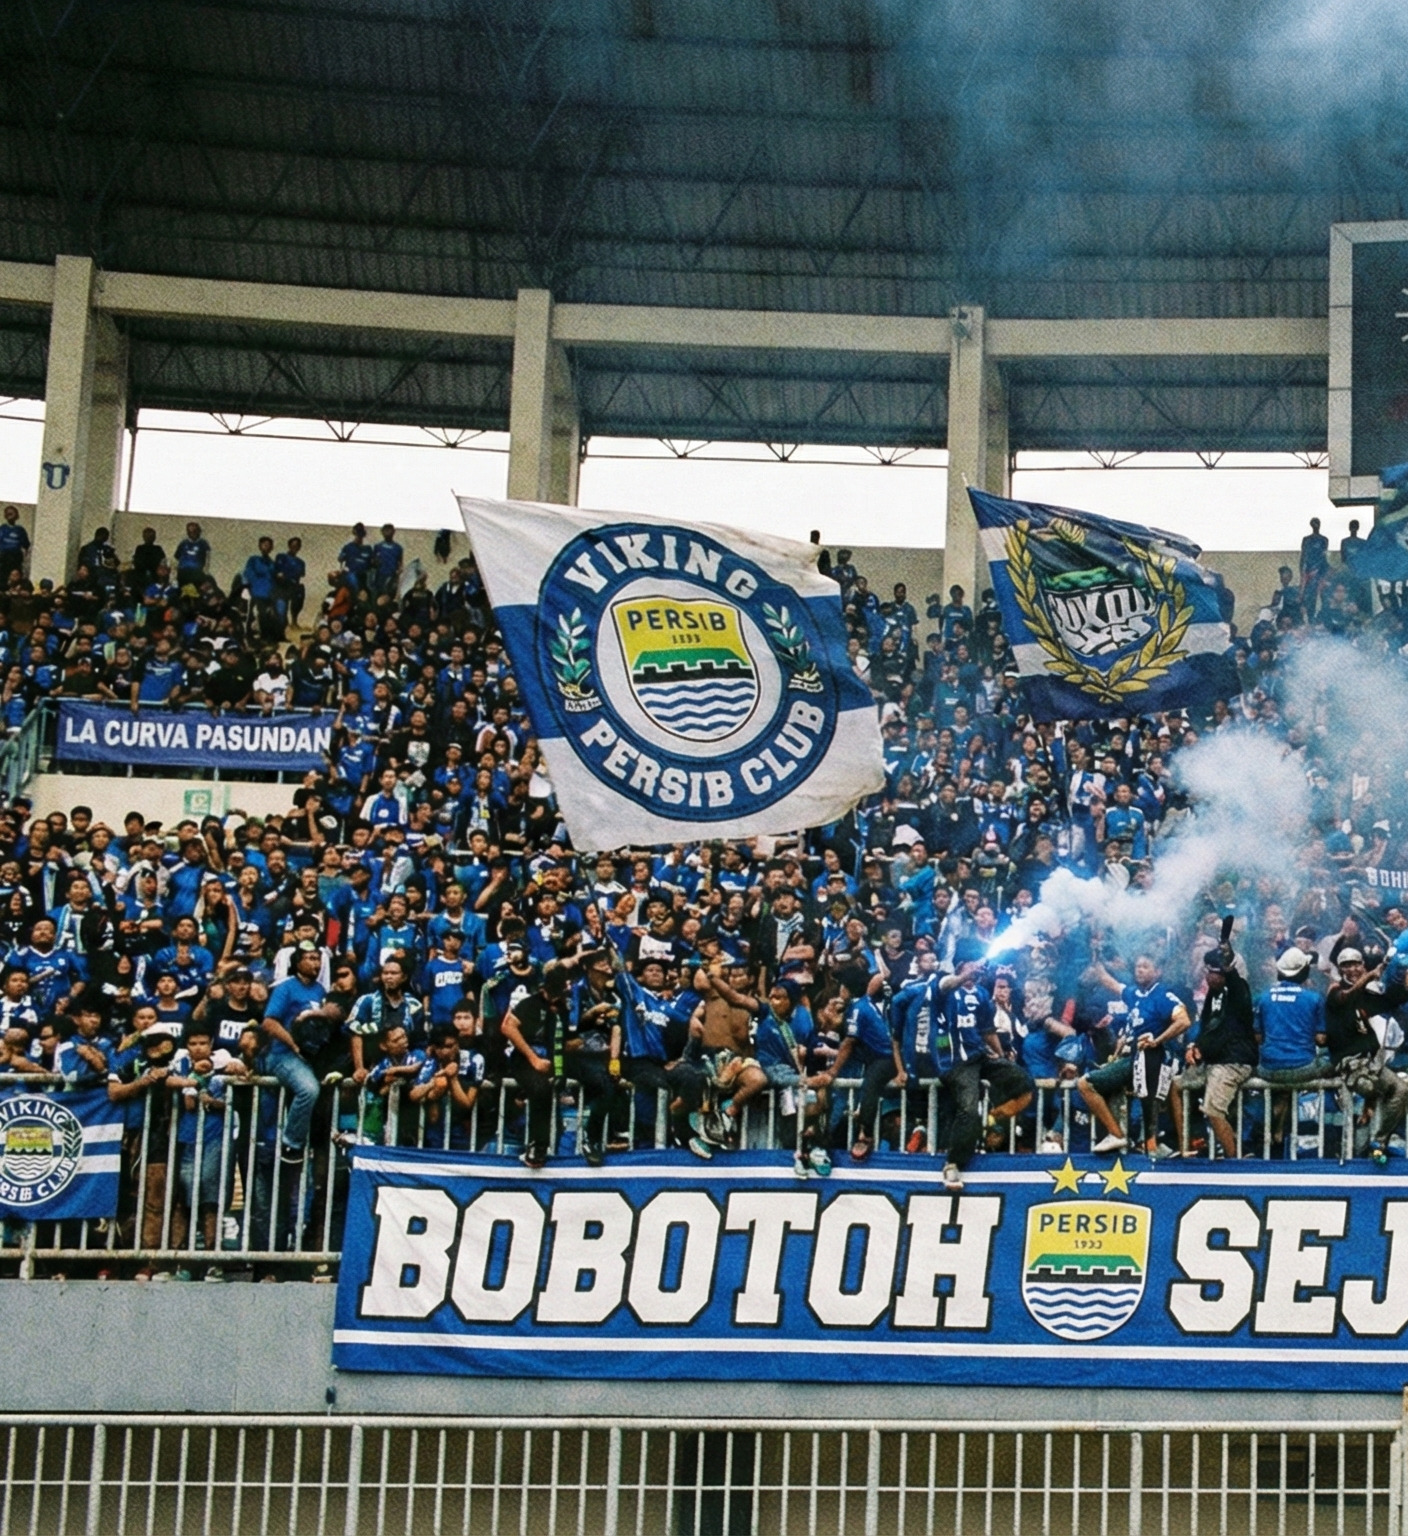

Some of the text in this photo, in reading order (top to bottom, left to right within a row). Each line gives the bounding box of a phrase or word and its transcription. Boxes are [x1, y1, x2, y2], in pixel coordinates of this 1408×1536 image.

[564, 533, 759, 600] VIKING
[627, 608, 726, 631] PERSIB
[65, 717, 332, 753] LA CURVA PASUNDAN
[580, 700, 825, 807] PERSIB CLUB
[0, 1101, 67, 1125] VIKING
[1040, 1213, 1138, 1234] PERSIB
[361, 1186, 1001, 1328] BOBOTOH
